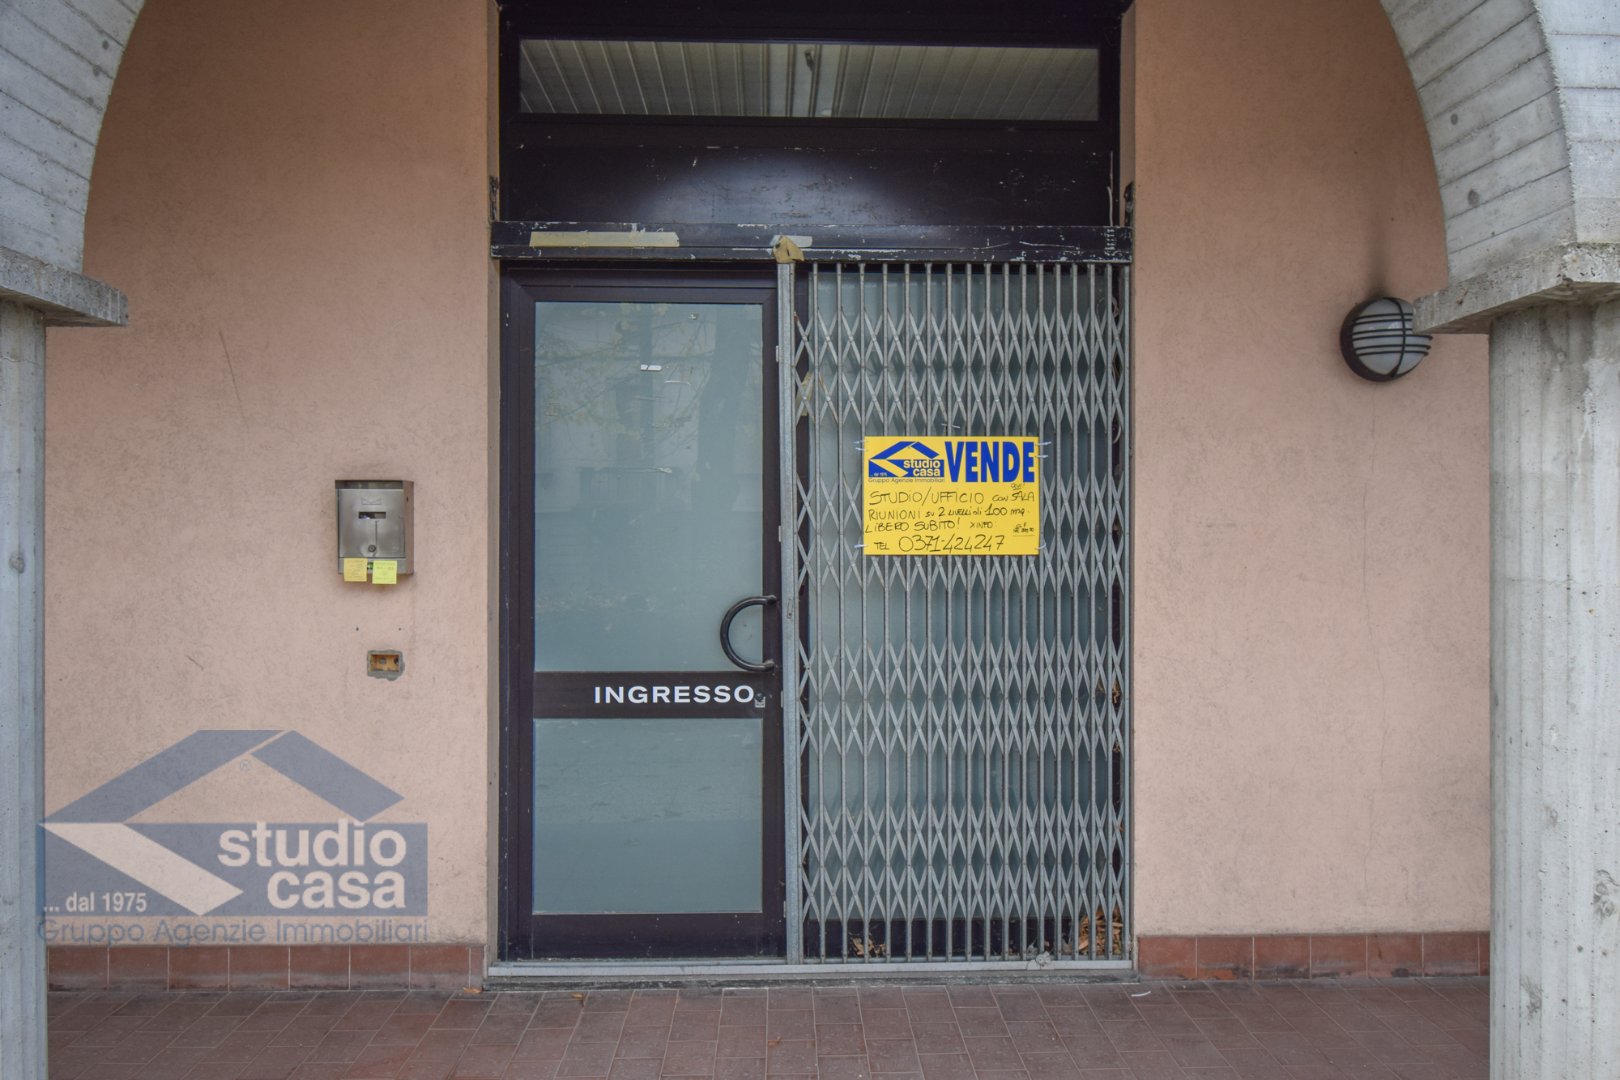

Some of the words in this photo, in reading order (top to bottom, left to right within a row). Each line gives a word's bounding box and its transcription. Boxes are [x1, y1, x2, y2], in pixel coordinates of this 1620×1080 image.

[903, 459, 941, 469] studio
[944, 441, 1035, 483] VENDE
[913, 468, 941, 477] casa
[1011, 491, 1035, 502] SALA
[938, 507, 946, 517] 2
[985, 504, 1008, 516] 100
[594, 685, 755, 704] INGRESSO
